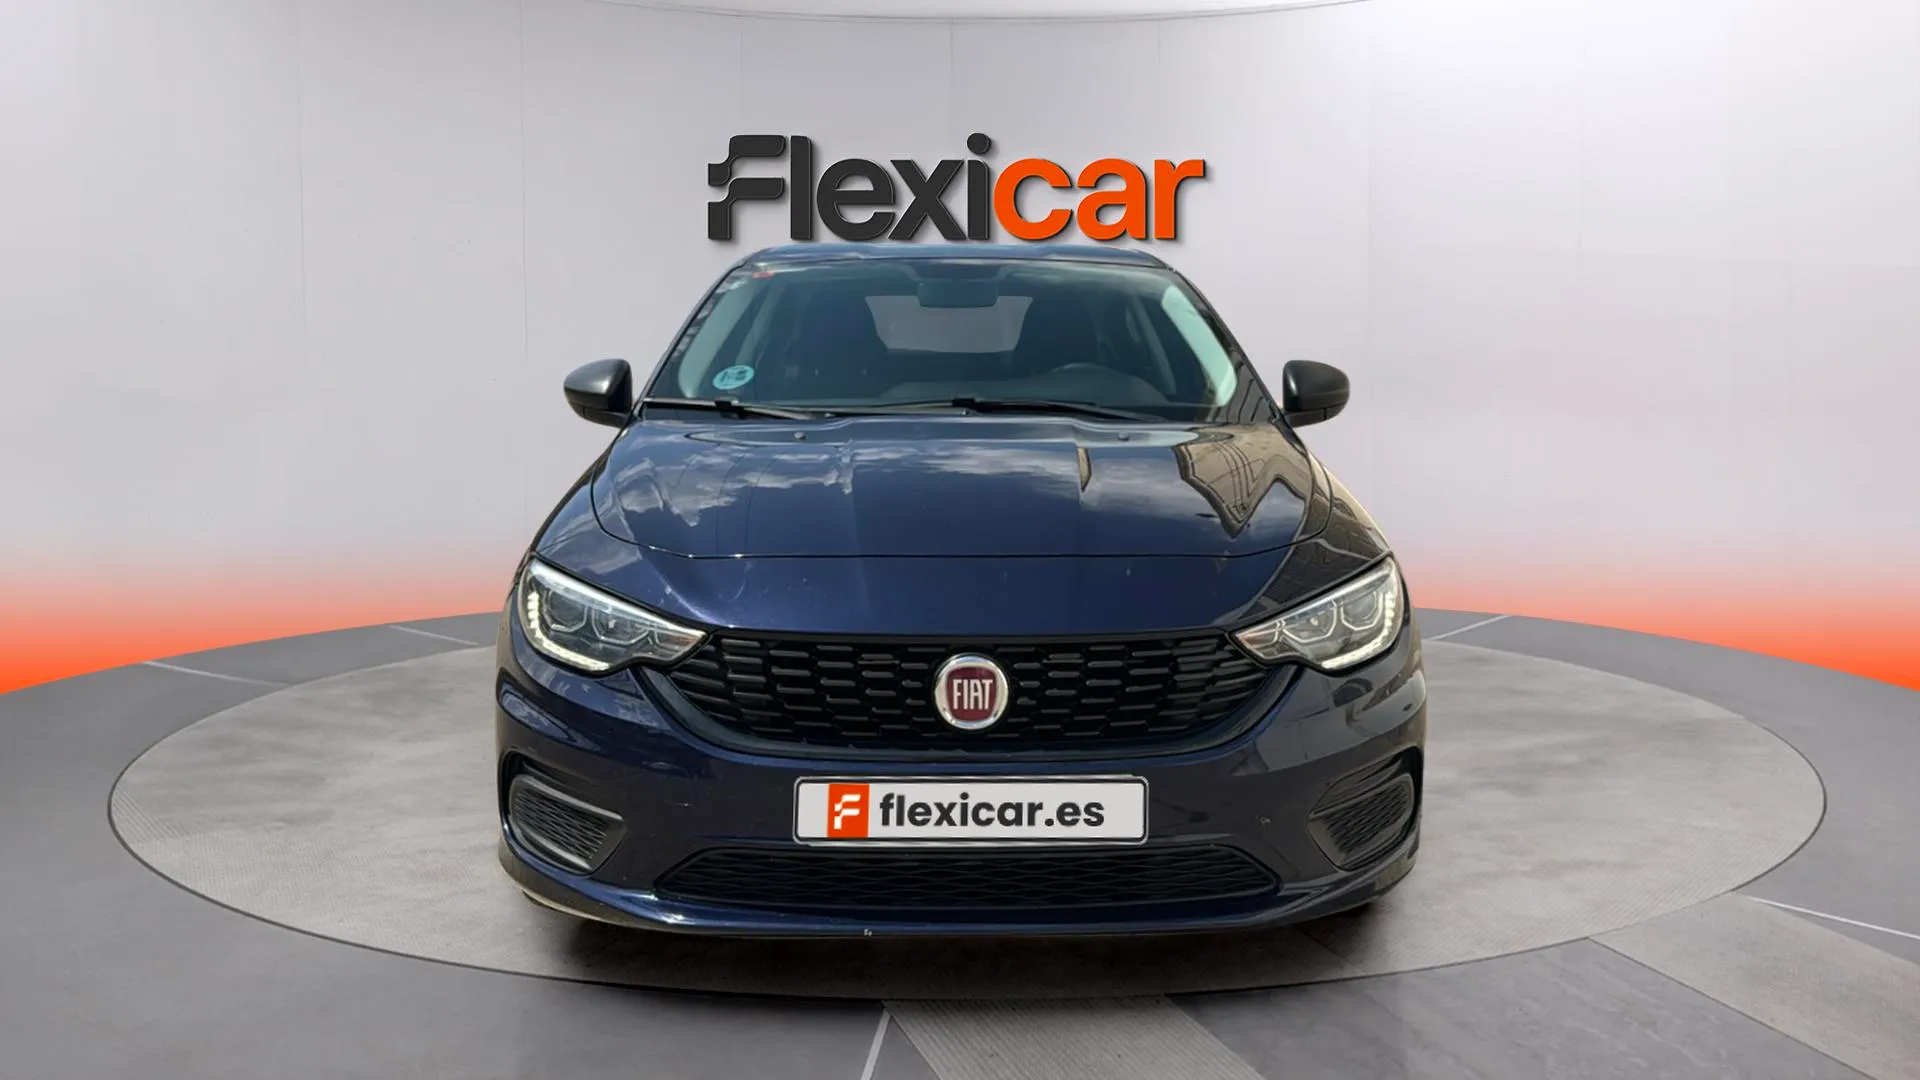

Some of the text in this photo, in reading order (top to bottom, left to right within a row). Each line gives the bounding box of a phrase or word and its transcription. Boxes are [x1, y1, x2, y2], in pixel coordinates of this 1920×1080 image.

[708, 132, 1205, 241] Flexicar
[952, 678, 994, 710] FIAT
[880, 792, 1105, 827] flexicar.es
